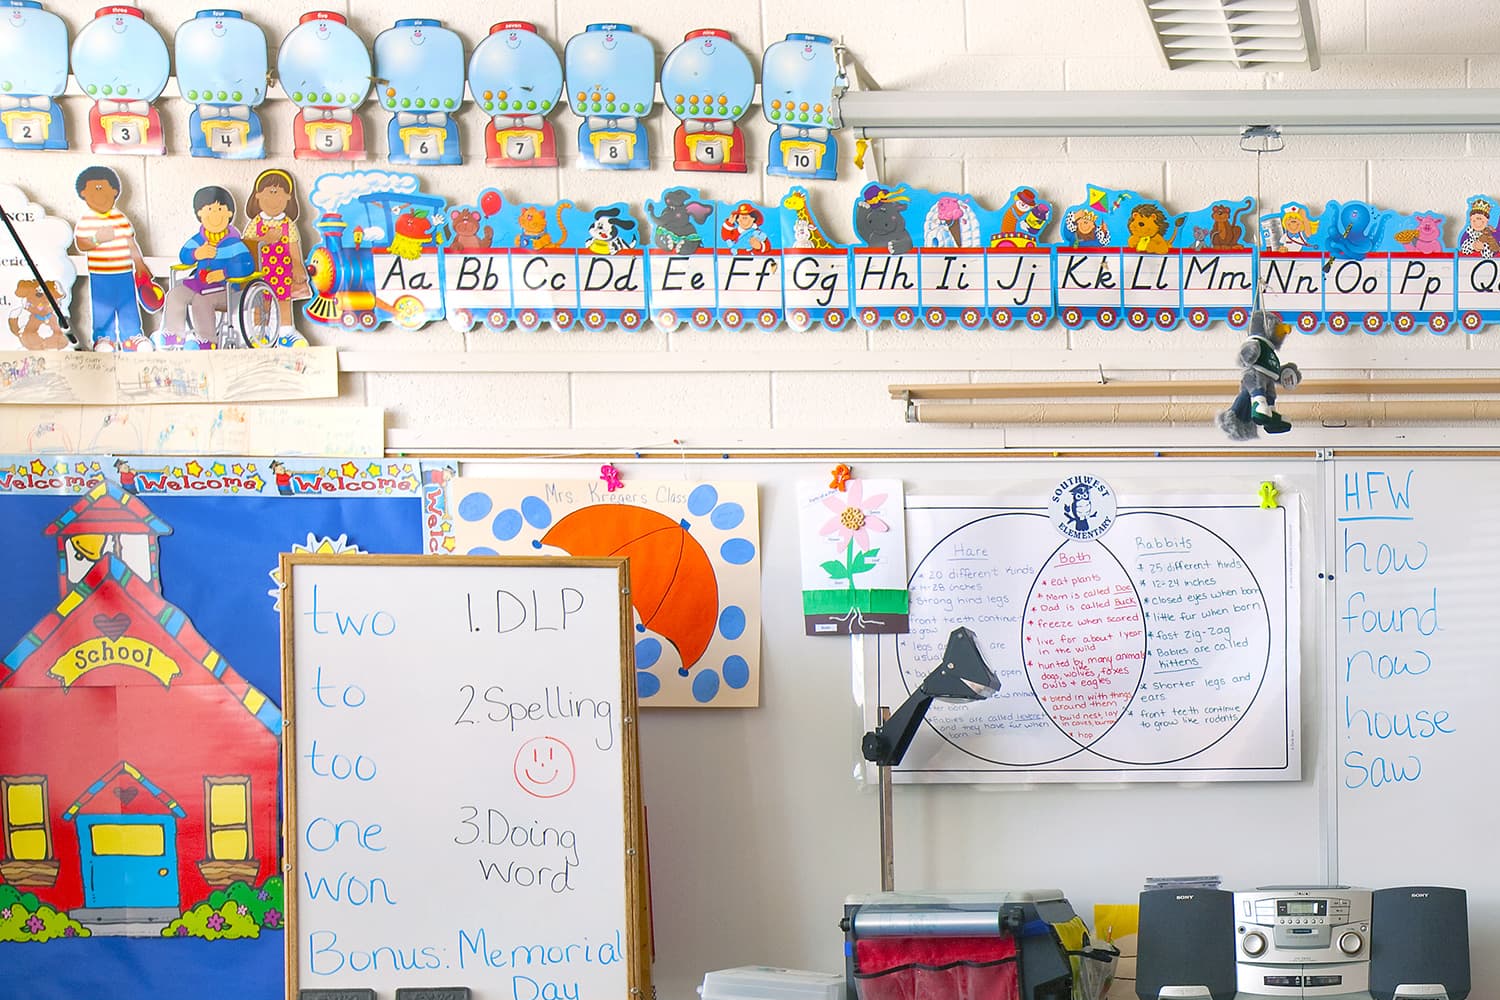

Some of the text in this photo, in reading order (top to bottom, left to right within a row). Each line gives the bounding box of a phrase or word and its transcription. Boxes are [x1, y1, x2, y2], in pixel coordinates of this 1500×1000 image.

[121, 127, 131, 141] 3
[419, 141, 428, 155] 6
[515, 142, 524, 156] 7
[704, 146, 715, 160] 9
[794, 154, 811, 168] 10
[381, 254, 434, 290] Aa
[456, 256, 500, 290] Bb
[522, 256, 567, 290] Cc
[583, 256, 639, 291] Dd
[662, 256, 706, 290] Ee
[724, 256, 772, 290] Ff
[793, 256, 839, 306] Gg
[860, 255, 915, 290] Hh
[935, 255, 971, 290] Ii
[996, 255, 1038, 306] Jj
[1060, 254, 1118, 290] Kk
[1130, 255, 1169, 290] Ll
[1183, 255, 1252, 290] Mm
[1262, 260, 1319, 294] Nn
[1334, 260, 1378, 294] Oo
[1399, 260, 1442, 310] Pp
[1052, 474, 1111, 504] SOUTHWEST
[1344, 469, 1415, 511] HFW
[1057, 515, 1115, 541] ELEMENTARY
[1135, 535, 1193, 551] Rabbits
[1058, 551, 1092, 565] Both
[1344, 527, 1429, 575] how
[304, 584, 397, 637] two
[497, 587, 584, 634] DLP
[1341, 587, 1446, 637] found
[75, 641, 153, 670] School
[311, 666, 366, 708] to
[1345, 695, 1457, 740] house
[304, 740, 378, 781] too
[306, 816, 387, 852] one
[304, 870, 398, 907] won
[309, 927, 625, 976] Bonus: Memorial
